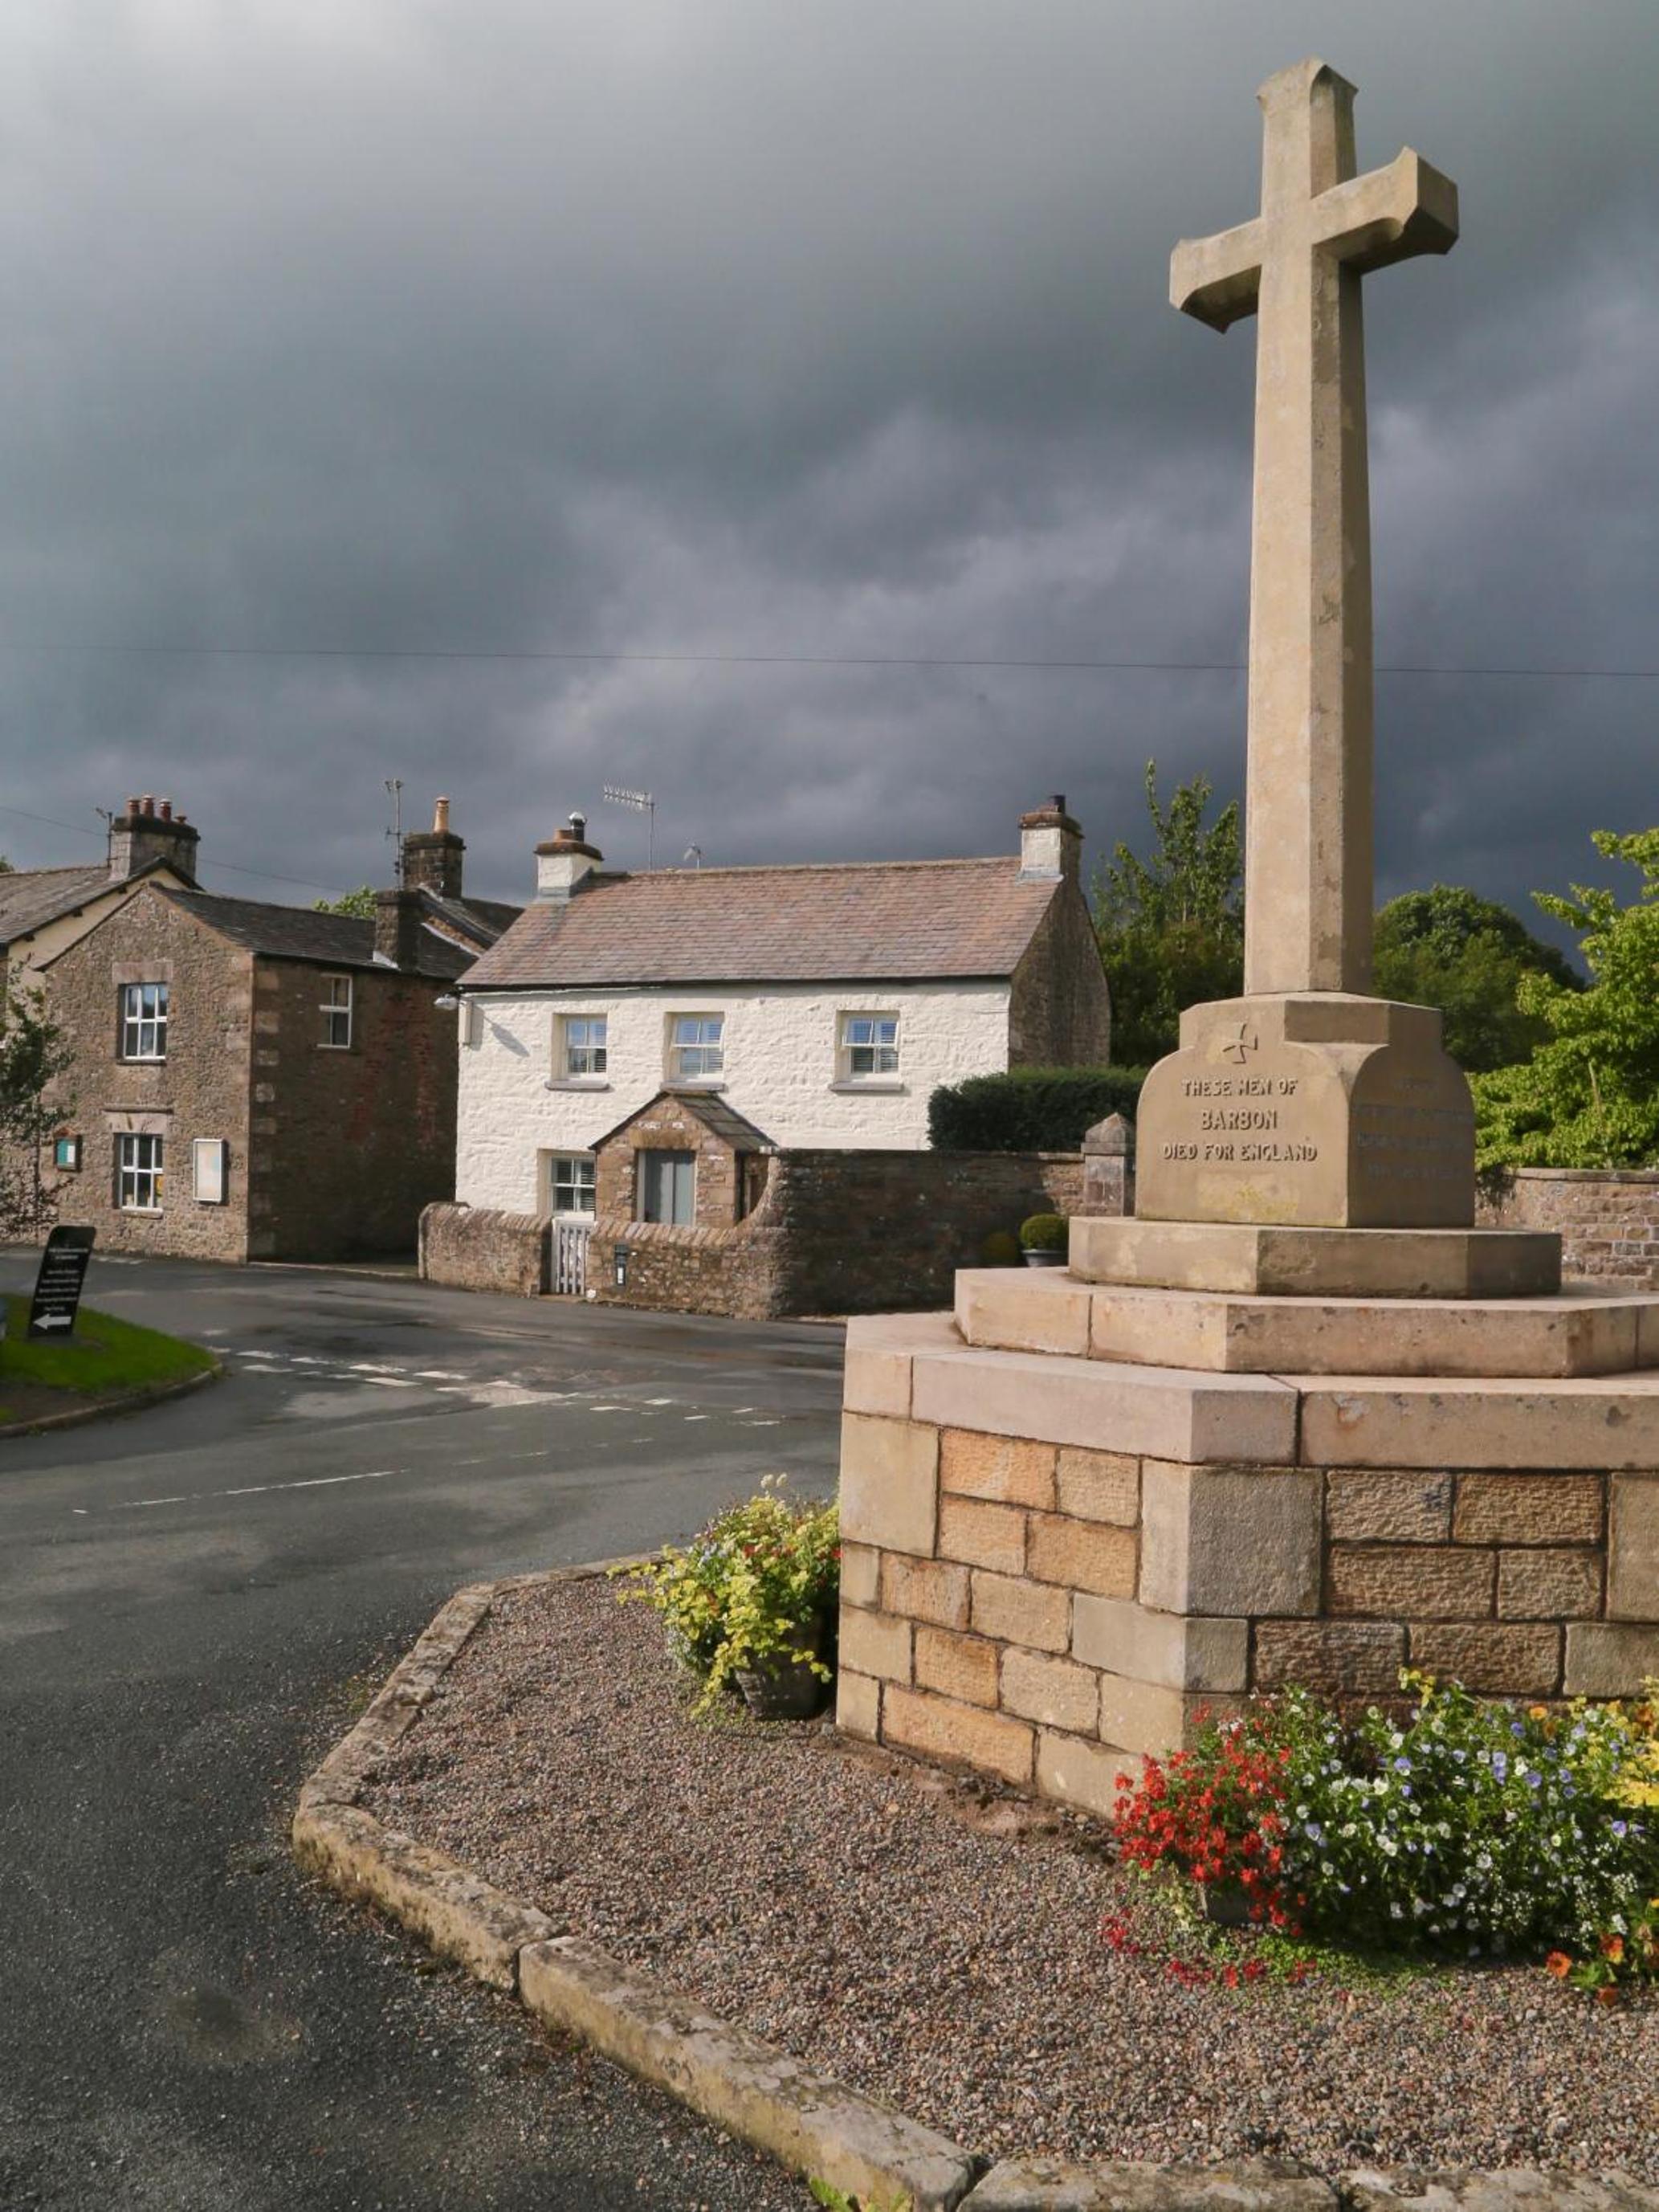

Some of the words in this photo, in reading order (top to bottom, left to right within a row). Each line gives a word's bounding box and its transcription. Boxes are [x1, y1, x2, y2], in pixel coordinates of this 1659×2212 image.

[1183, 1079, 1233, 1097] THESE
[1237, 1079, 1272, 1097] MEN
[1278, 1079, 1298, 1096] OF
[1201, 1108, 1278, 1131] BARBON
[1164, 1144, 1198, 1161] DIED
[1205, 1144, 1235, 1161] FOR
[1241, 1144, 1319, 1162] ENGLAND
